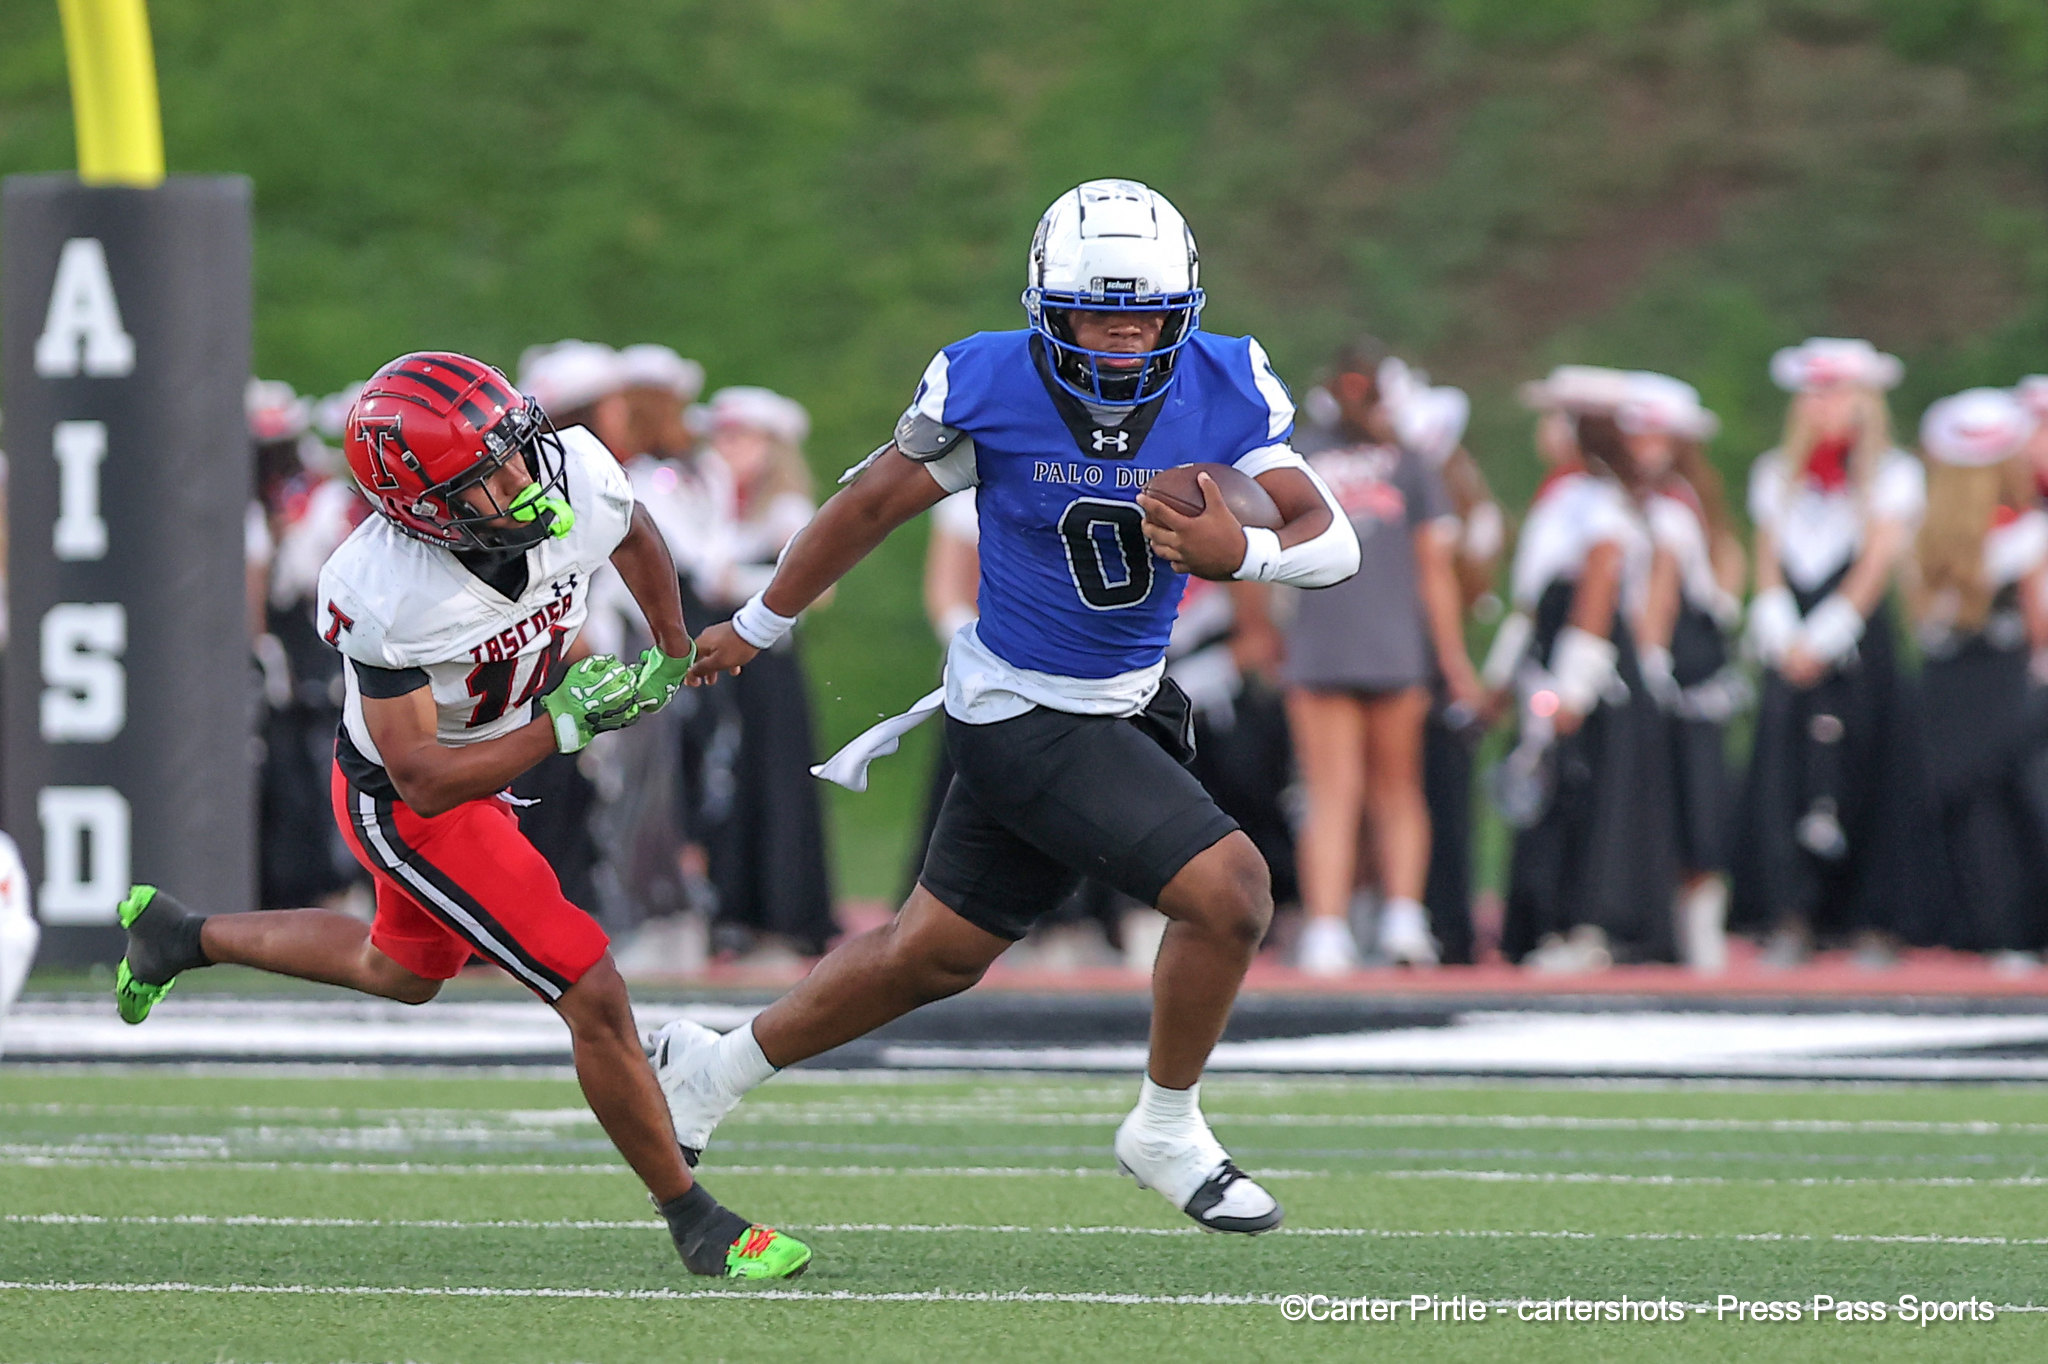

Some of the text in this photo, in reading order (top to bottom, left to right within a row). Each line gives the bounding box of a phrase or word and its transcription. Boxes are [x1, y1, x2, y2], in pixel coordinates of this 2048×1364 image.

[355, 416, 401, 489] T
[1033, 461, 1164, 489] PALO DU
[34, 237, 136, 926] AISD
[1057, 496, 1155, 611] 0
[324, 599, 354, 647] T
